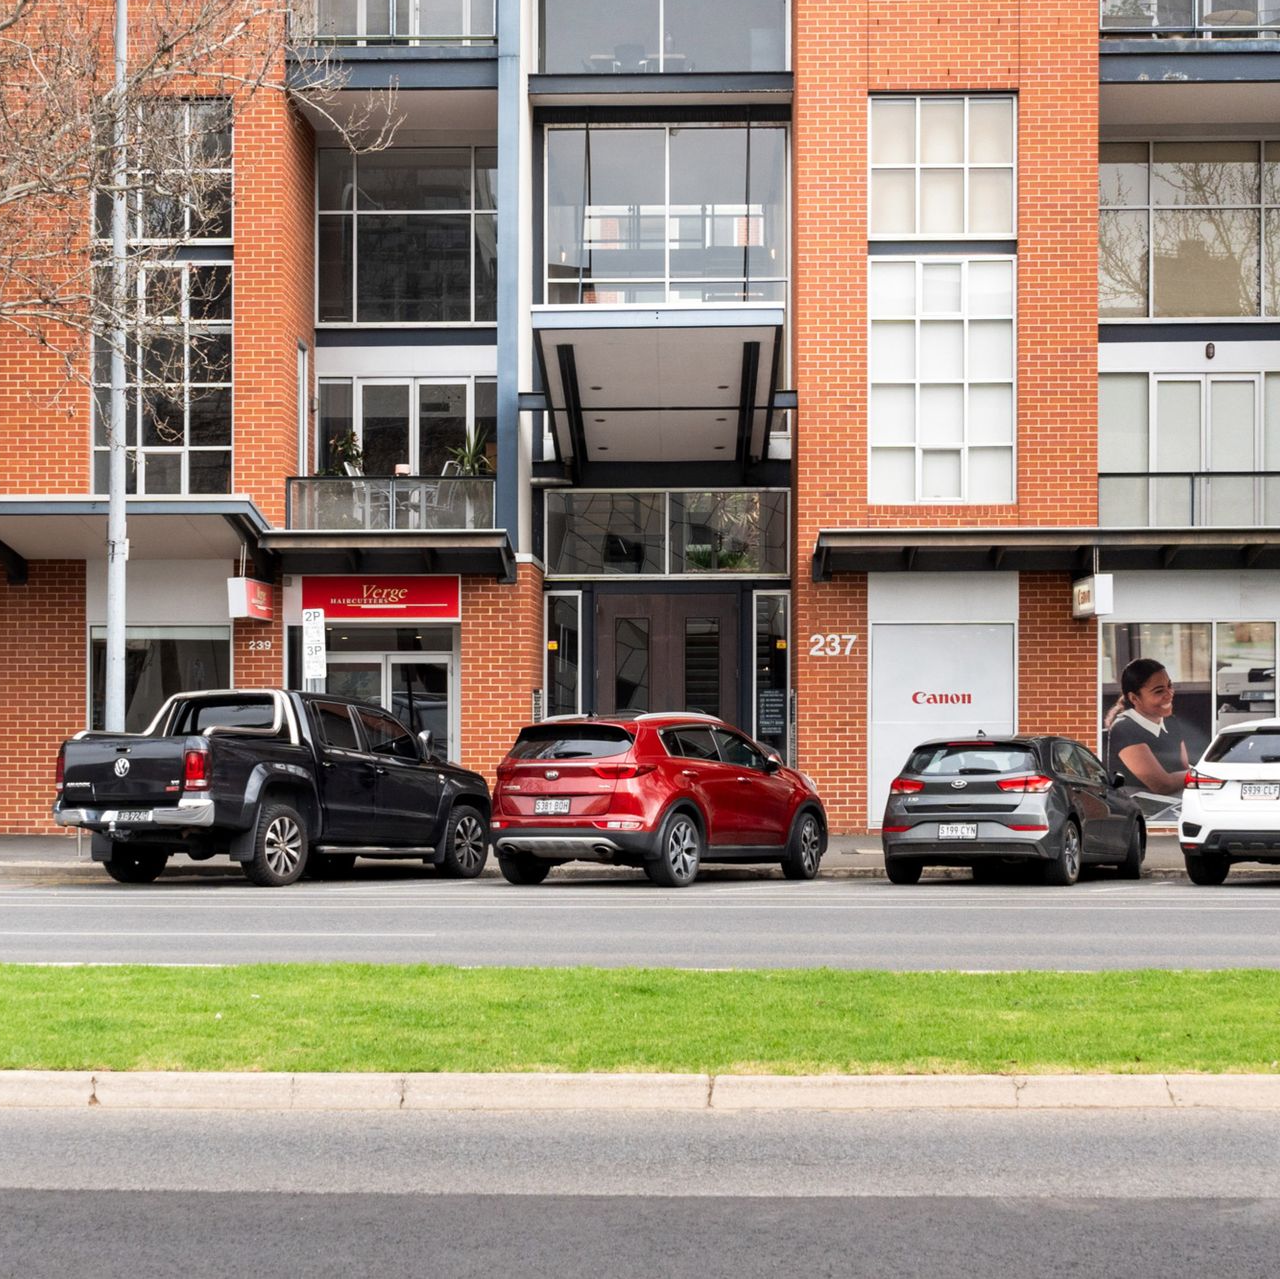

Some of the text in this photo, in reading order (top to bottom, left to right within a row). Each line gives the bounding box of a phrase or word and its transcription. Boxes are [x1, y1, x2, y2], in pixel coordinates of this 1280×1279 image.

[362, 584, 408, 603] Verge
[305, 611, 321, 622] 2P
[249, 640, 271, 650] 239
[307, 645, 322, 656] 3P
[809, 634, 857, 656] 237
[911, 691, 972, 705] Canon
[1243, 786, 1261, 795] S939
